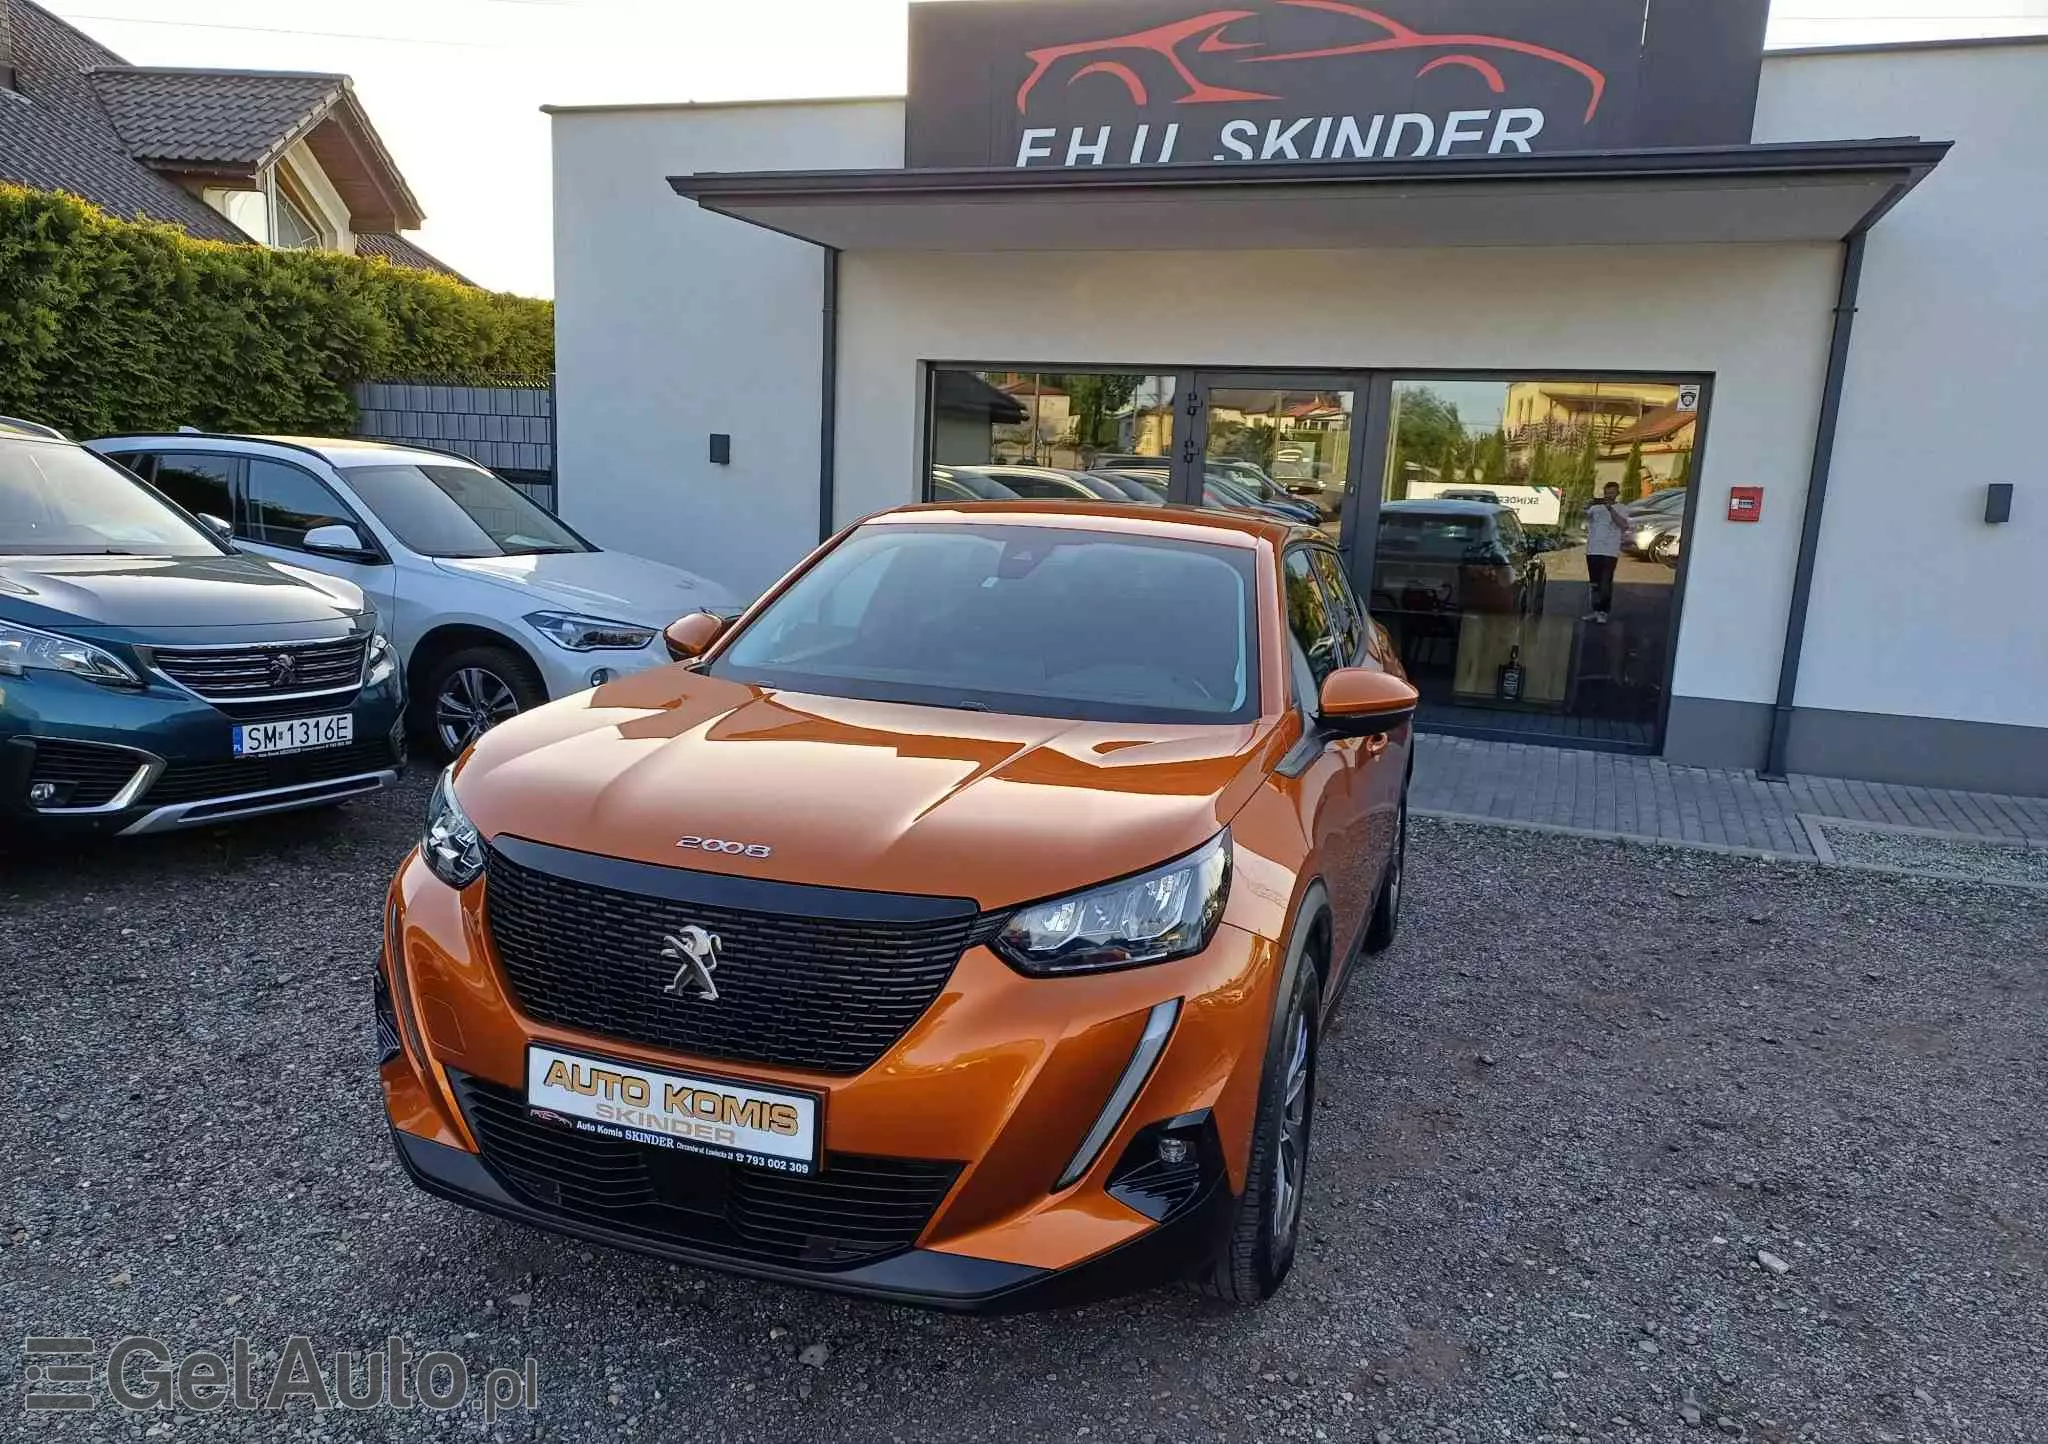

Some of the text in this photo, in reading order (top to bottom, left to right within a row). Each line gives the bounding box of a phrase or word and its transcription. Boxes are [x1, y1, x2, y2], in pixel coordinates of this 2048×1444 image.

[1213, 107, 1545, 161] SKINDER
[675, 835, 771, 858] 2008
[543, 1059, 799, 1136] AUTO KOMIS
[595, 1103, 736, 1145] SKINDER
[576, 1120, 596, 1132] Auto
[597, 1125, 623, 1138] Komis
[625, 1129, 678, 1149] SKINDER
[747, 1155, 765, 1167] 793
[767, 1158, 787, 1170] 002
[789, 1161, 809, 1174] 309
